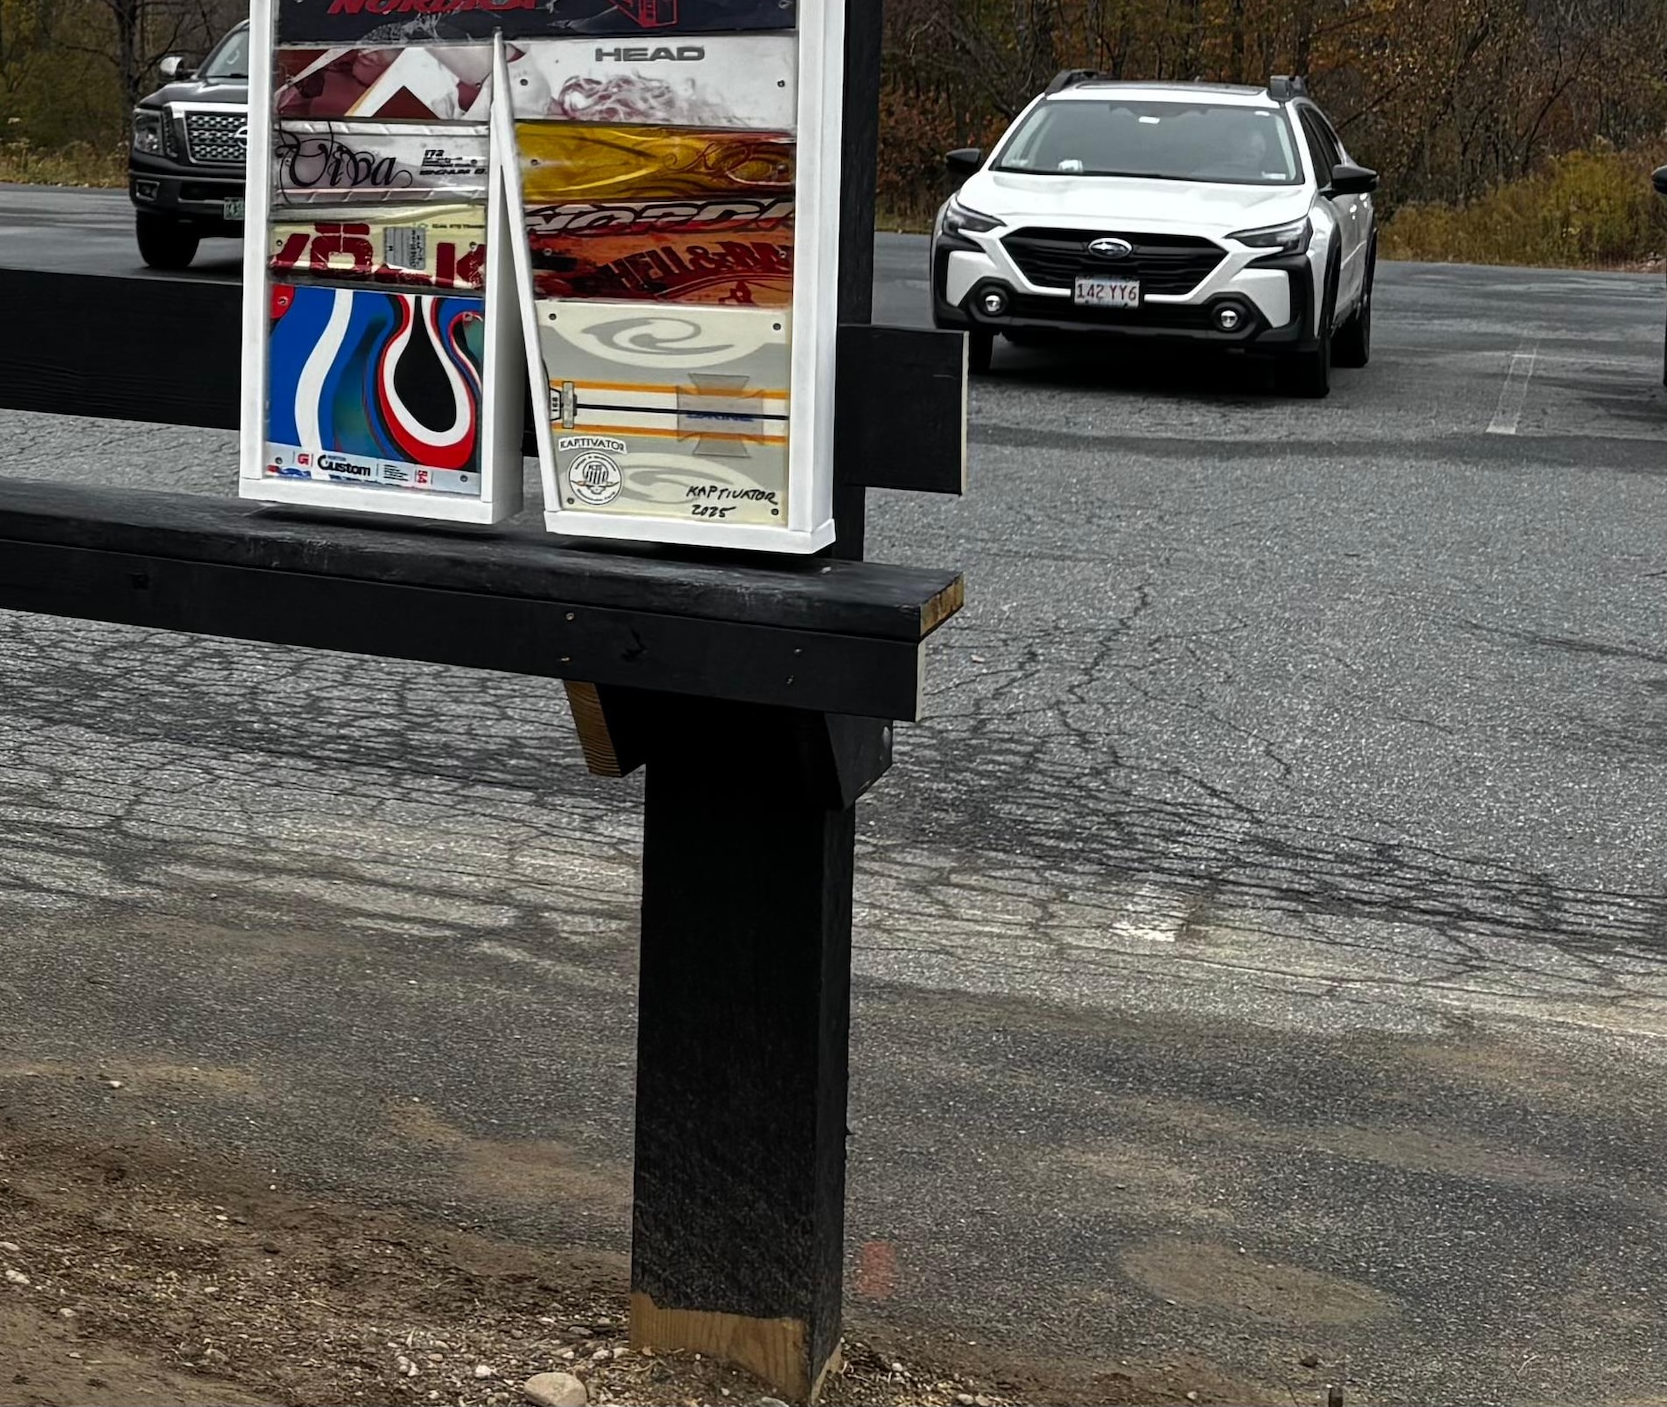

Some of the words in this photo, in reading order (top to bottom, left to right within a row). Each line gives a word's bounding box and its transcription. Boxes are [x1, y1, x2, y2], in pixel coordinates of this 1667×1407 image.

[594, 45, 706, 63] HEAD
[558, 436, 628, 454] KAPTIVATOR
[316, 454, 372, 478] Custom
[691, 503, 738, 520] 2025
